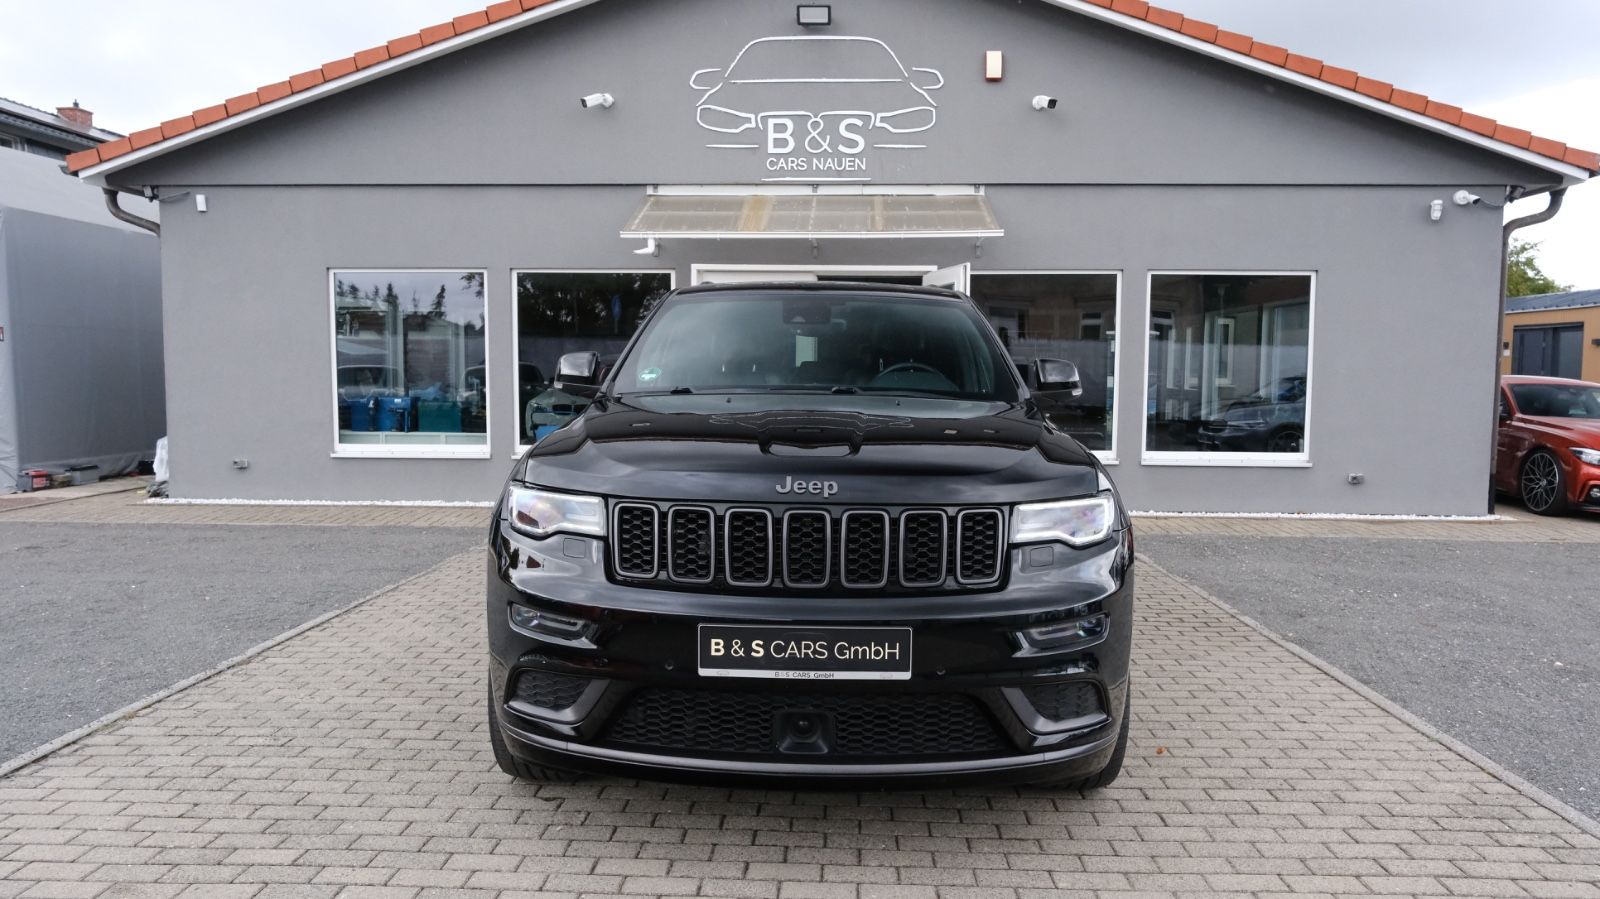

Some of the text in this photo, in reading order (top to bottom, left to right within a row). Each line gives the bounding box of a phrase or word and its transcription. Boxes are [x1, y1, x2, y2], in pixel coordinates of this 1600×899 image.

[766, 157, 866, 171] CARS NAUEN
[775, 475, 838, 498] Jeep
[710, 638, 900, 661] B & S CARS GmbH
[792, 671, 811, 679] CARS
